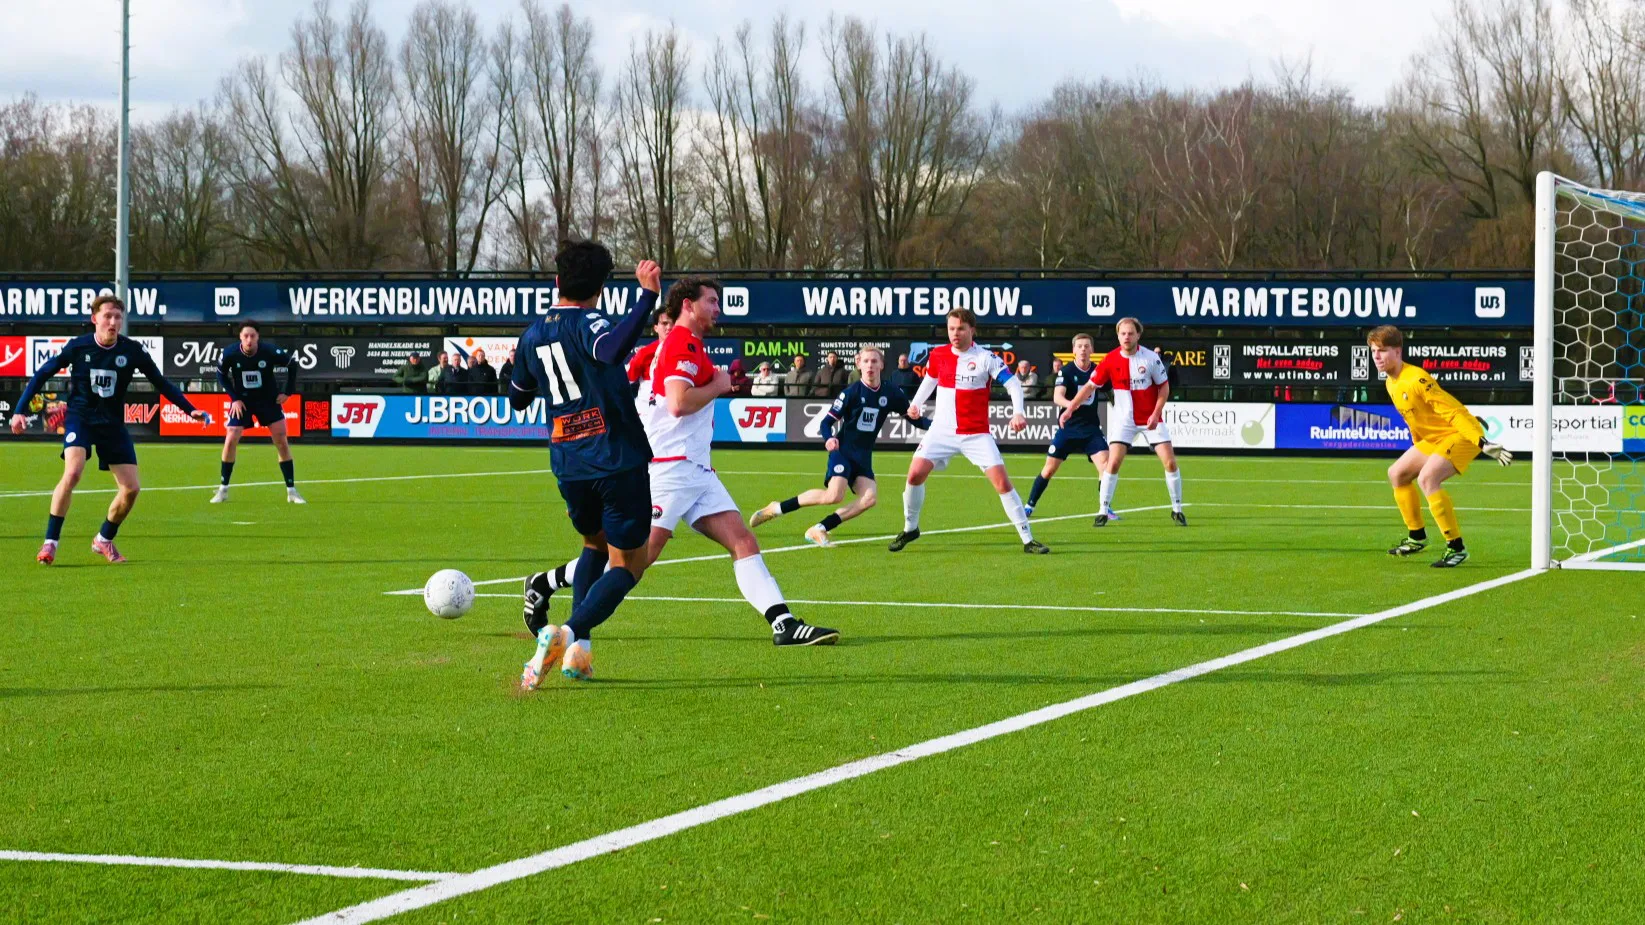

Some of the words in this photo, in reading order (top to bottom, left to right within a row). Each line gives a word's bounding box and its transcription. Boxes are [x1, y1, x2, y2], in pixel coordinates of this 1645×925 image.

[802, 286, 1033, 317] WARMTEBOUW.
[1172, 286, 1417, 318] WARMTEBOUW.
[744, 341, 810, 357] DAM-NL
[1242, 345, 1339, 357] INSTALLATEURS
[1408, 346, 1507, 358] INSTALLATEURS
[536, 341, 582, 406] 11
[1243, 370, 1338, 380] www.utinbo.nl
[124, 403, 160, 423] KAV
[337, 402, 379, 424] JBT
[738, 405, 783, 429] JBT
[989, 405, 1053, 419] PECALIST
[1164, 404, 1237, 425] riessen
[1170, 426, 1236, 437] akVermaak
[1310, 425, 1410, 440] RuimteUtrecht
[1508, 415, 1617, 433] trasportial
